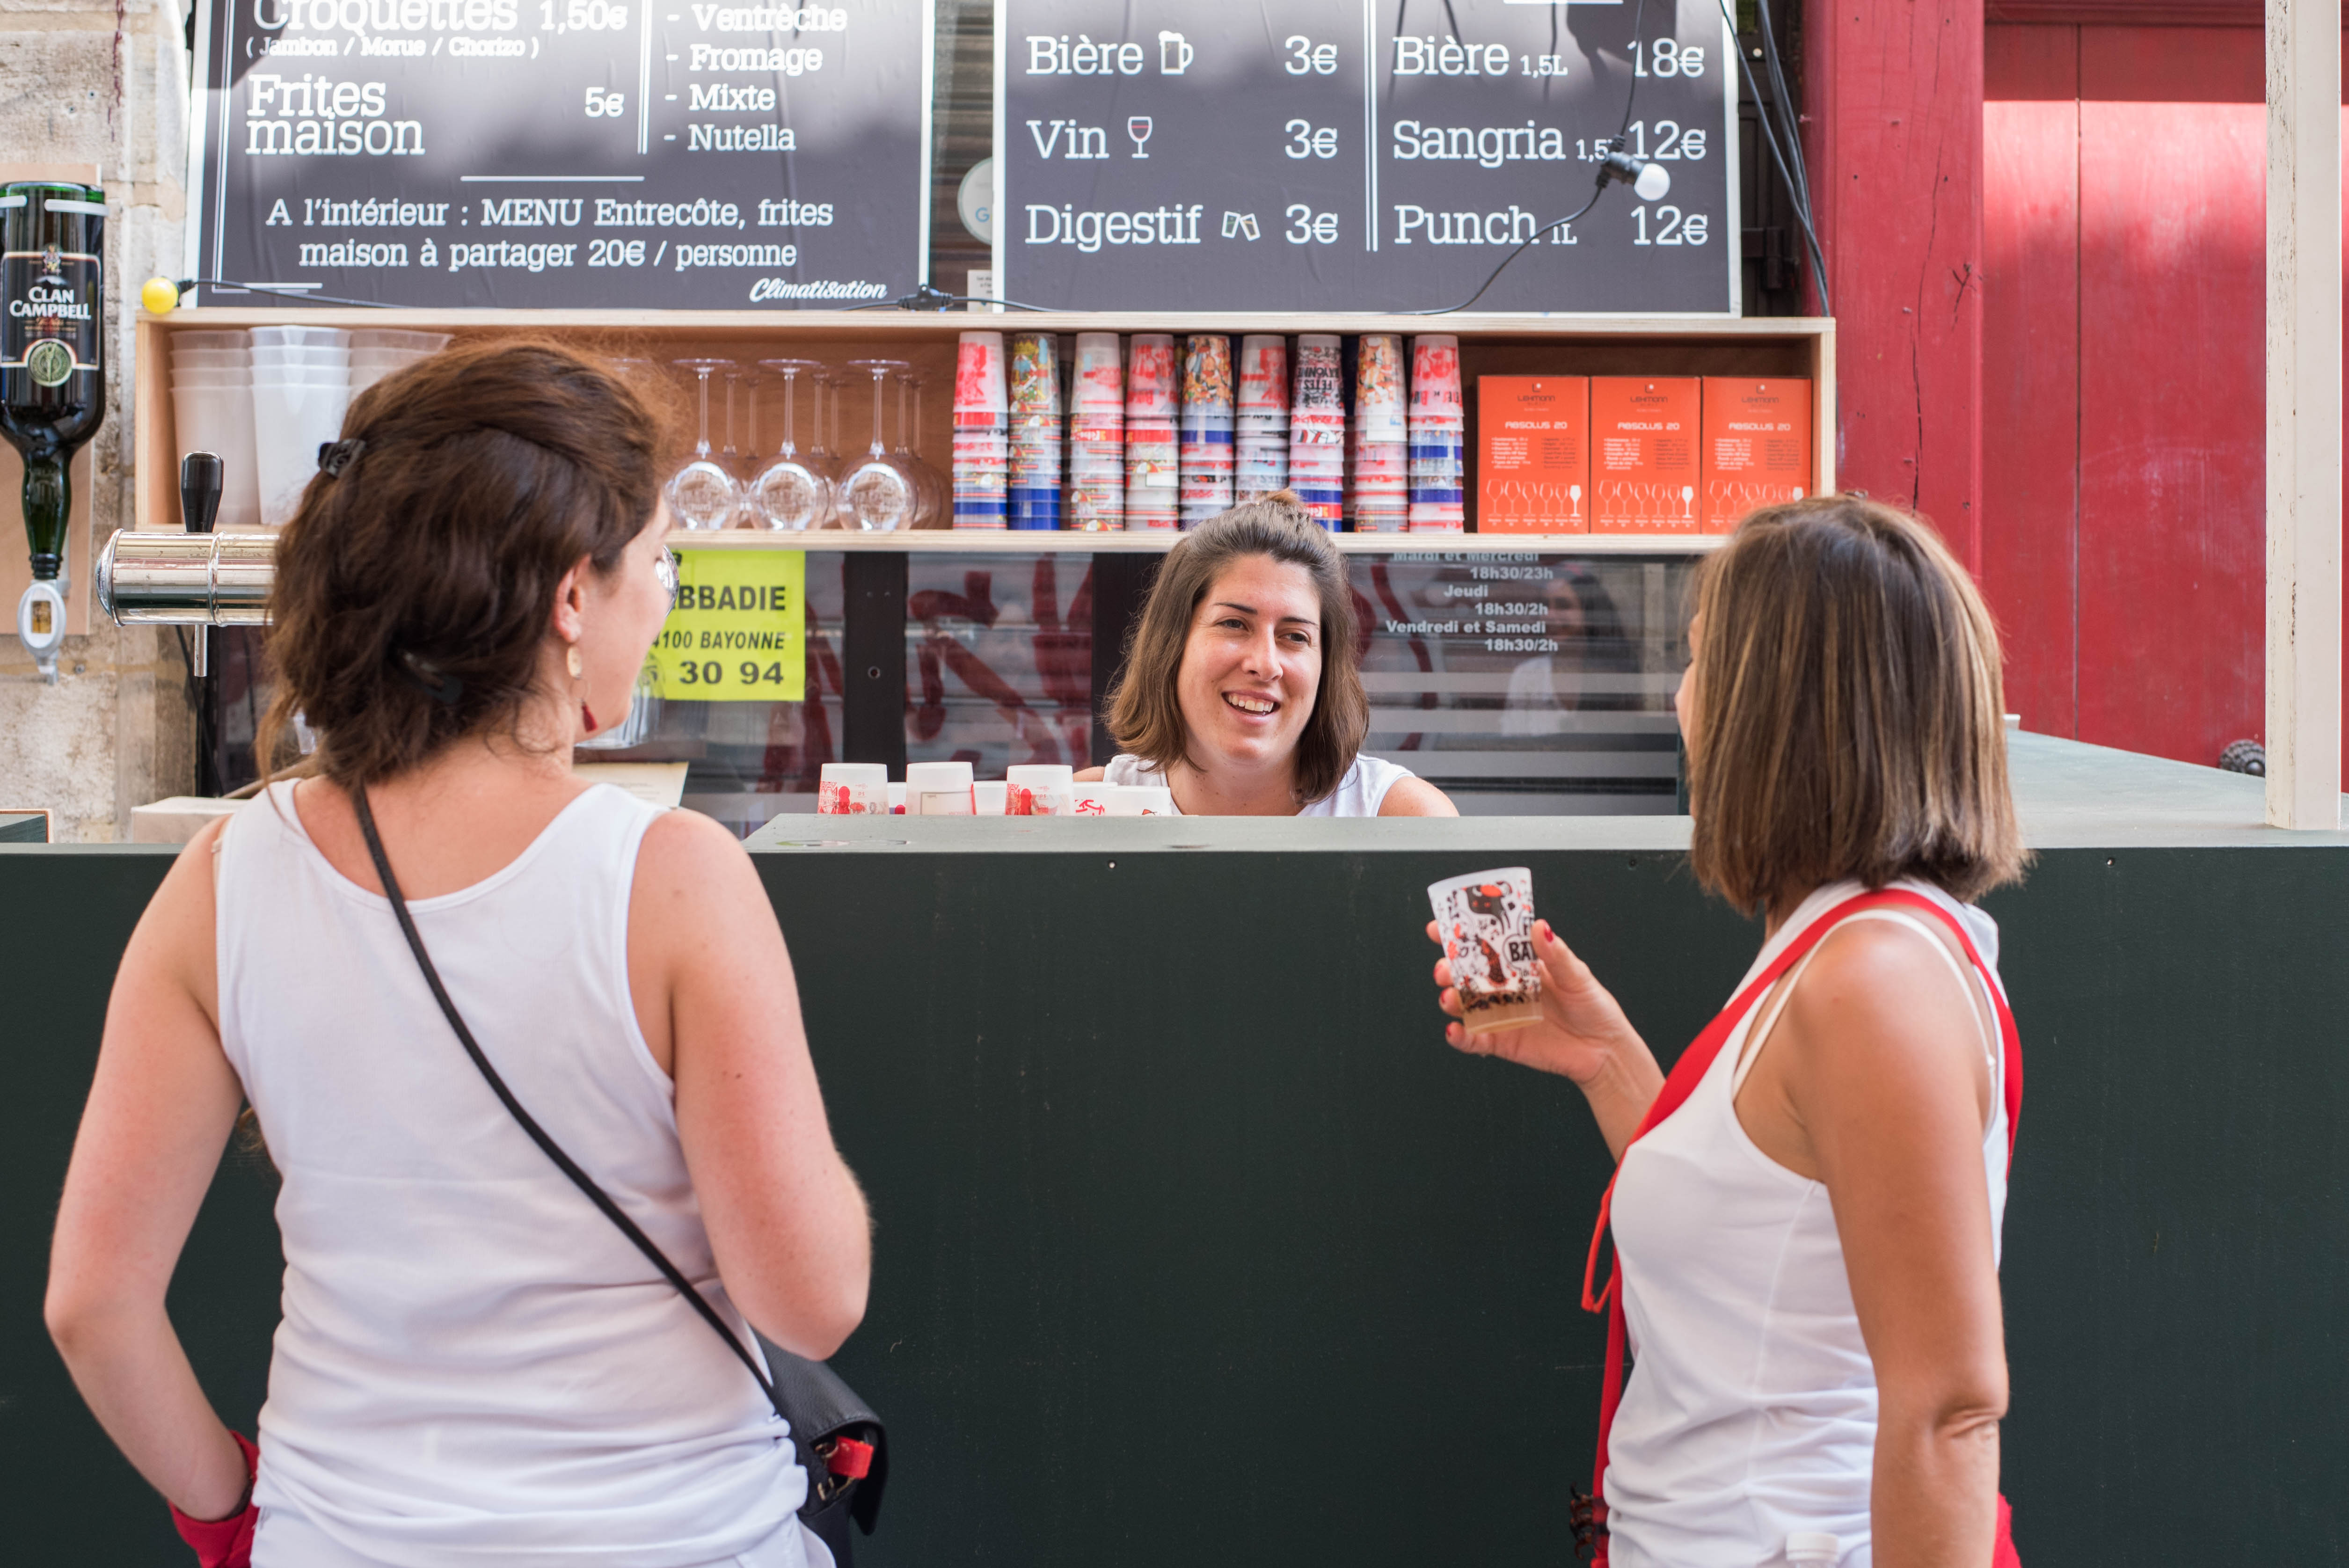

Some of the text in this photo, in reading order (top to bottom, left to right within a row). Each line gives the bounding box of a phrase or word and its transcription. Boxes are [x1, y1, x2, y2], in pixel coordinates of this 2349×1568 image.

[254, 0, 628, 36] Croquettes 1,50€
[692, 4, 848, 31] Ventrèche
[259, 36, 337, 56] Jambon
[360, 37, 426, 56] Morue
[449, 37, 525, 56] Chorizo
[1026, 34, 1338, 75] Bière 3€
[1392, 35, 1705, 79] Bière 1,5L 18€
[689, 44, 823, 76] Fromage
[247, 73, 624, 117] Frites 5€
[689, 84, 776, 111] Mixte
[245, 117, 425, 155] maison
[687, 124, 796, 151] Nutella
[1026, 119, 1338, 160] Vin 3€
[1393, 120, 1707, 168] Sangria 1,5 12€
[266, 199, 292, 226] A
[481, 198, 583, 226] MENU
[594, 197, 745, 230] Entrecôte,
[758, 198, 833, 226] frites
[1394, 204, 1539, 245] Punch
[1630, 204, 1708, 245] 12€
[1025, 204, 1339, 253] Digestif 3€
[299, 238, 409, 267] maison
[420, 238, 438, 267] à
[448, 242, 576, 272] partager
[589, 239, 645, 267] 20€
[676, 242, 797, 271] personne
[28, 286, 74, 304] CLAN
[749, 278, 887, 302] Climatisation
[9, 300, 92, 321] CAMPBELL
[1470, 567, 1554, 579] 18h30/23h
[673, 586, 785, 610] BBADIE
[1444, 585, 1488, 598] Jeudi
[1475, 603, 1548, 615] 18h30/2h
[1386, 620, 1546, 633] Vendredi et Samedi
[700, 632, 785, 649] BAYONNE
[1485, 639, 1559, 651] 18h30/2h
[679, 661, 784, 685] 30 94
